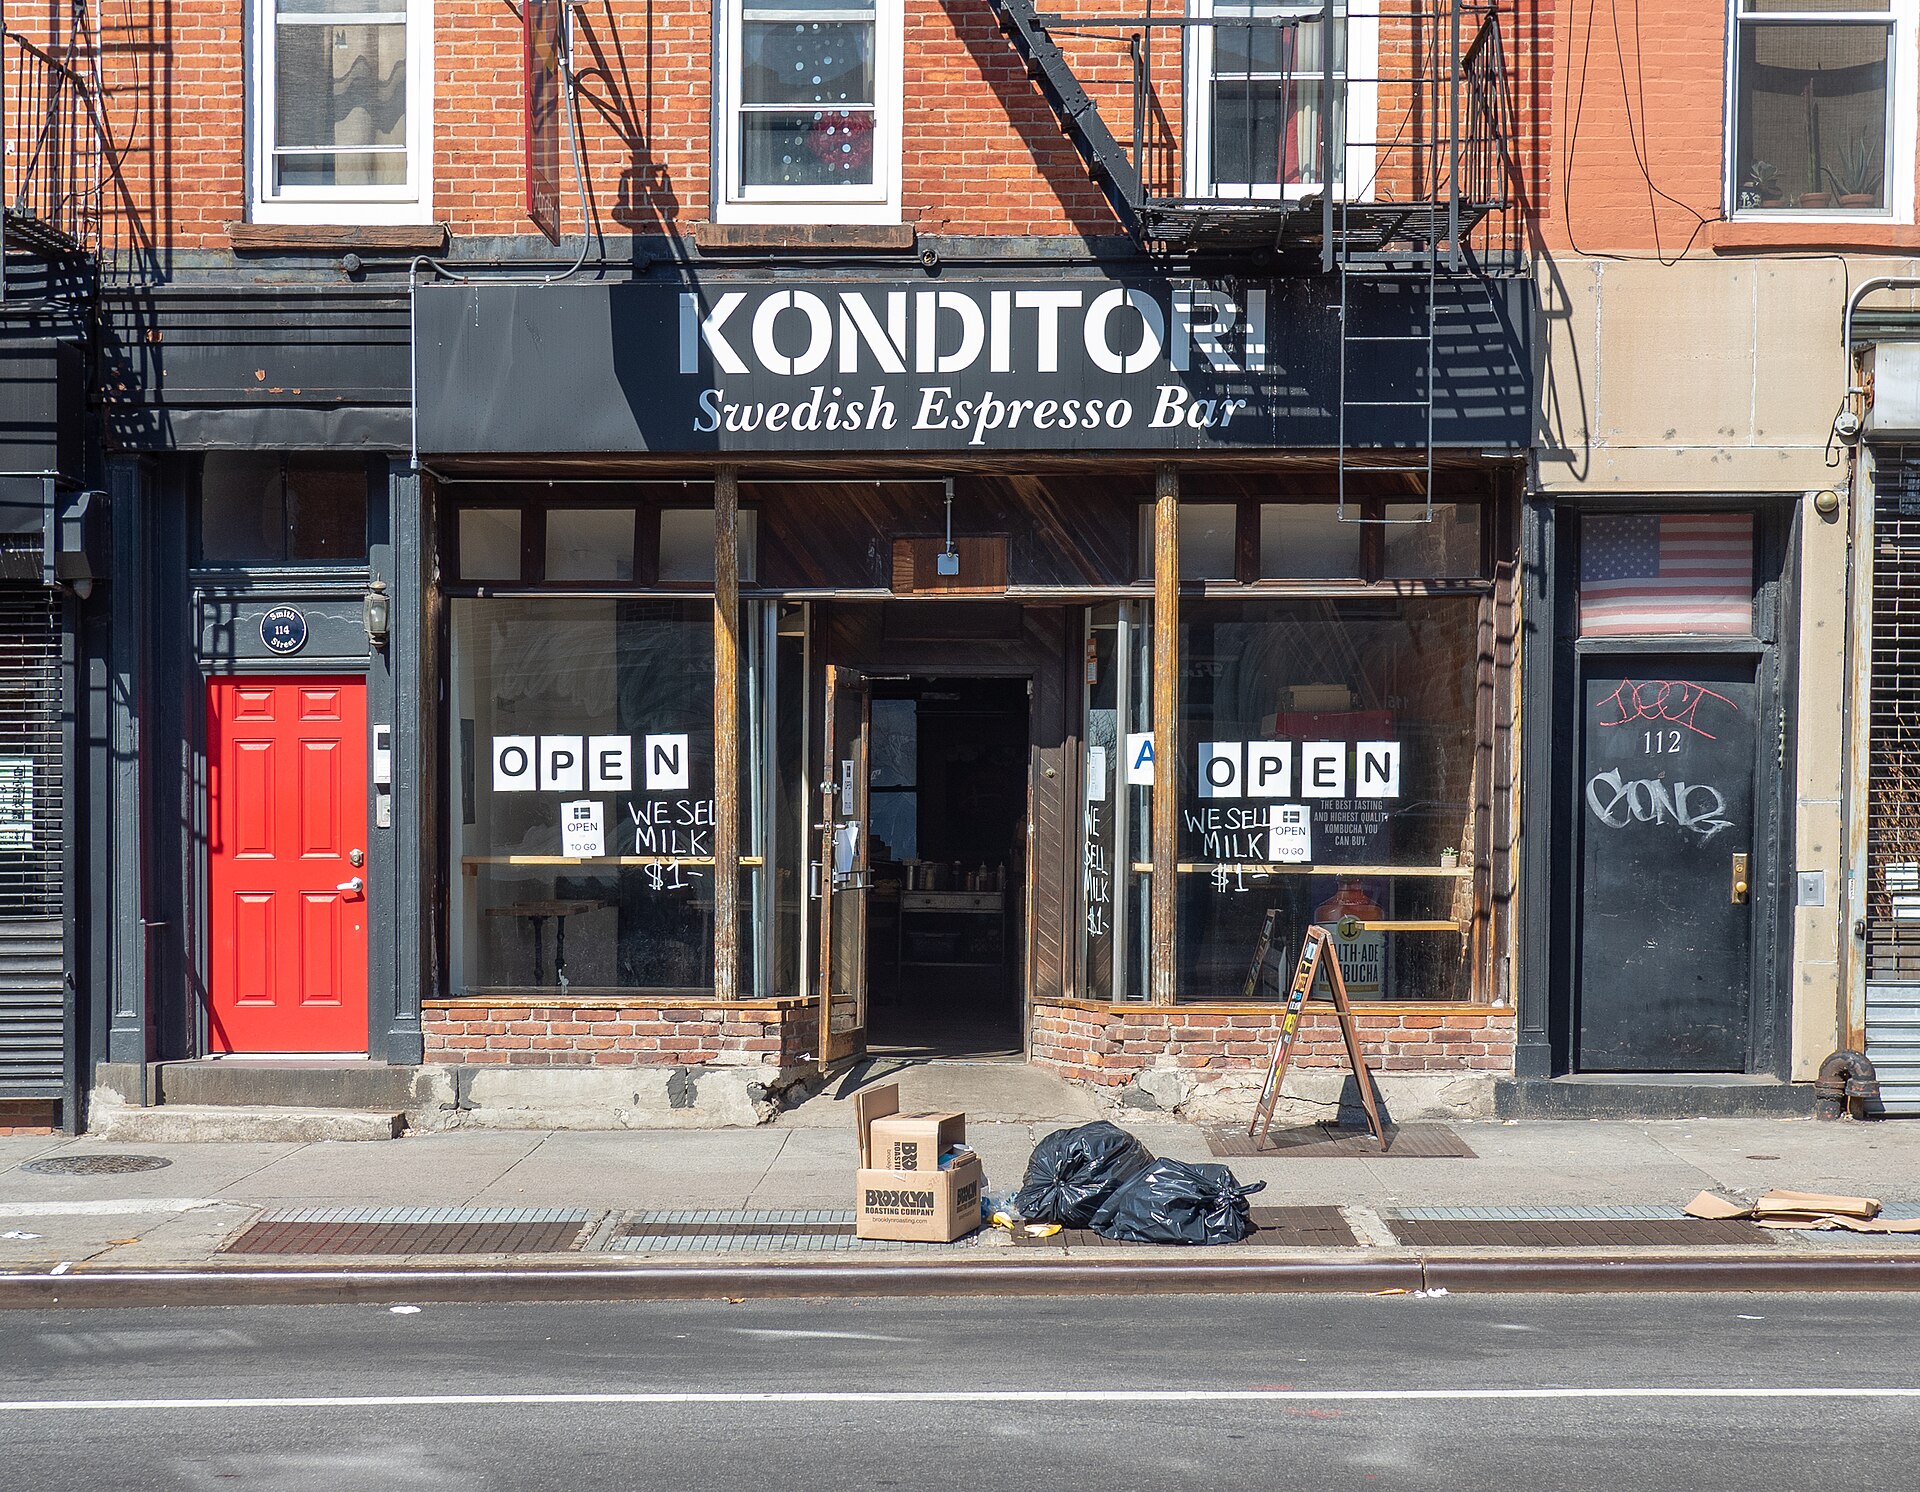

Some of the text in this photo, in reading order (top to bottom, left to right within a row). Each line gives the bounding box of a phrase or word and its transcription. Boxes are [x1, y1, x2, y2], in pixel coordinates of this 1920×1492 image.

[678, 288, 1266, 375] KONDITORI
[692, 384, 1246, 445] Swedish Espresso Bar
[270, 610, 295, 620] Smith
[275, 625, 290, 635] 114
[271, 638, 296, 648] Street
[1644, 730, 1681, 754] 112
[499, 743, 679, 781] OPEN
[1134, 740, 1155, 769] A
[1205, 751, 1391, 788] OPEN
[628, 800, 715, 825] WE SEL
[1320, 800, 1383, 810] THE BEST TASTING
[1085, 805, 1101, 837] WE
[1184, 807, 1270, 834] WE SELL
[1313, 812, 1328, 822] AND
[1330, 812, 1358, 822] HIGHEST
[567, 822, 598, 832] OPEN
[1275, 826, 1306, 836] OPEN
[1324, 824, 1378, 834] KOMBUCHA YOU
[570, 843, 597, 851] TO GO
[635, 826, 708, 855] MILK
[1203, 832, 1264, 860] MILK
[1334, 836, 1367, 846] CAN BUY.
[1083, 841, 1109, 876] SELL
[1278, 847, 1304, 856] TO GO
[1320, 964, 1378, 983] KBUCHA
[902, 1142, 917, 1171] BRO
[865, 1190, 934, 1208] BROOKLYN
[865, 1207, 899, 1215] ROASTING
